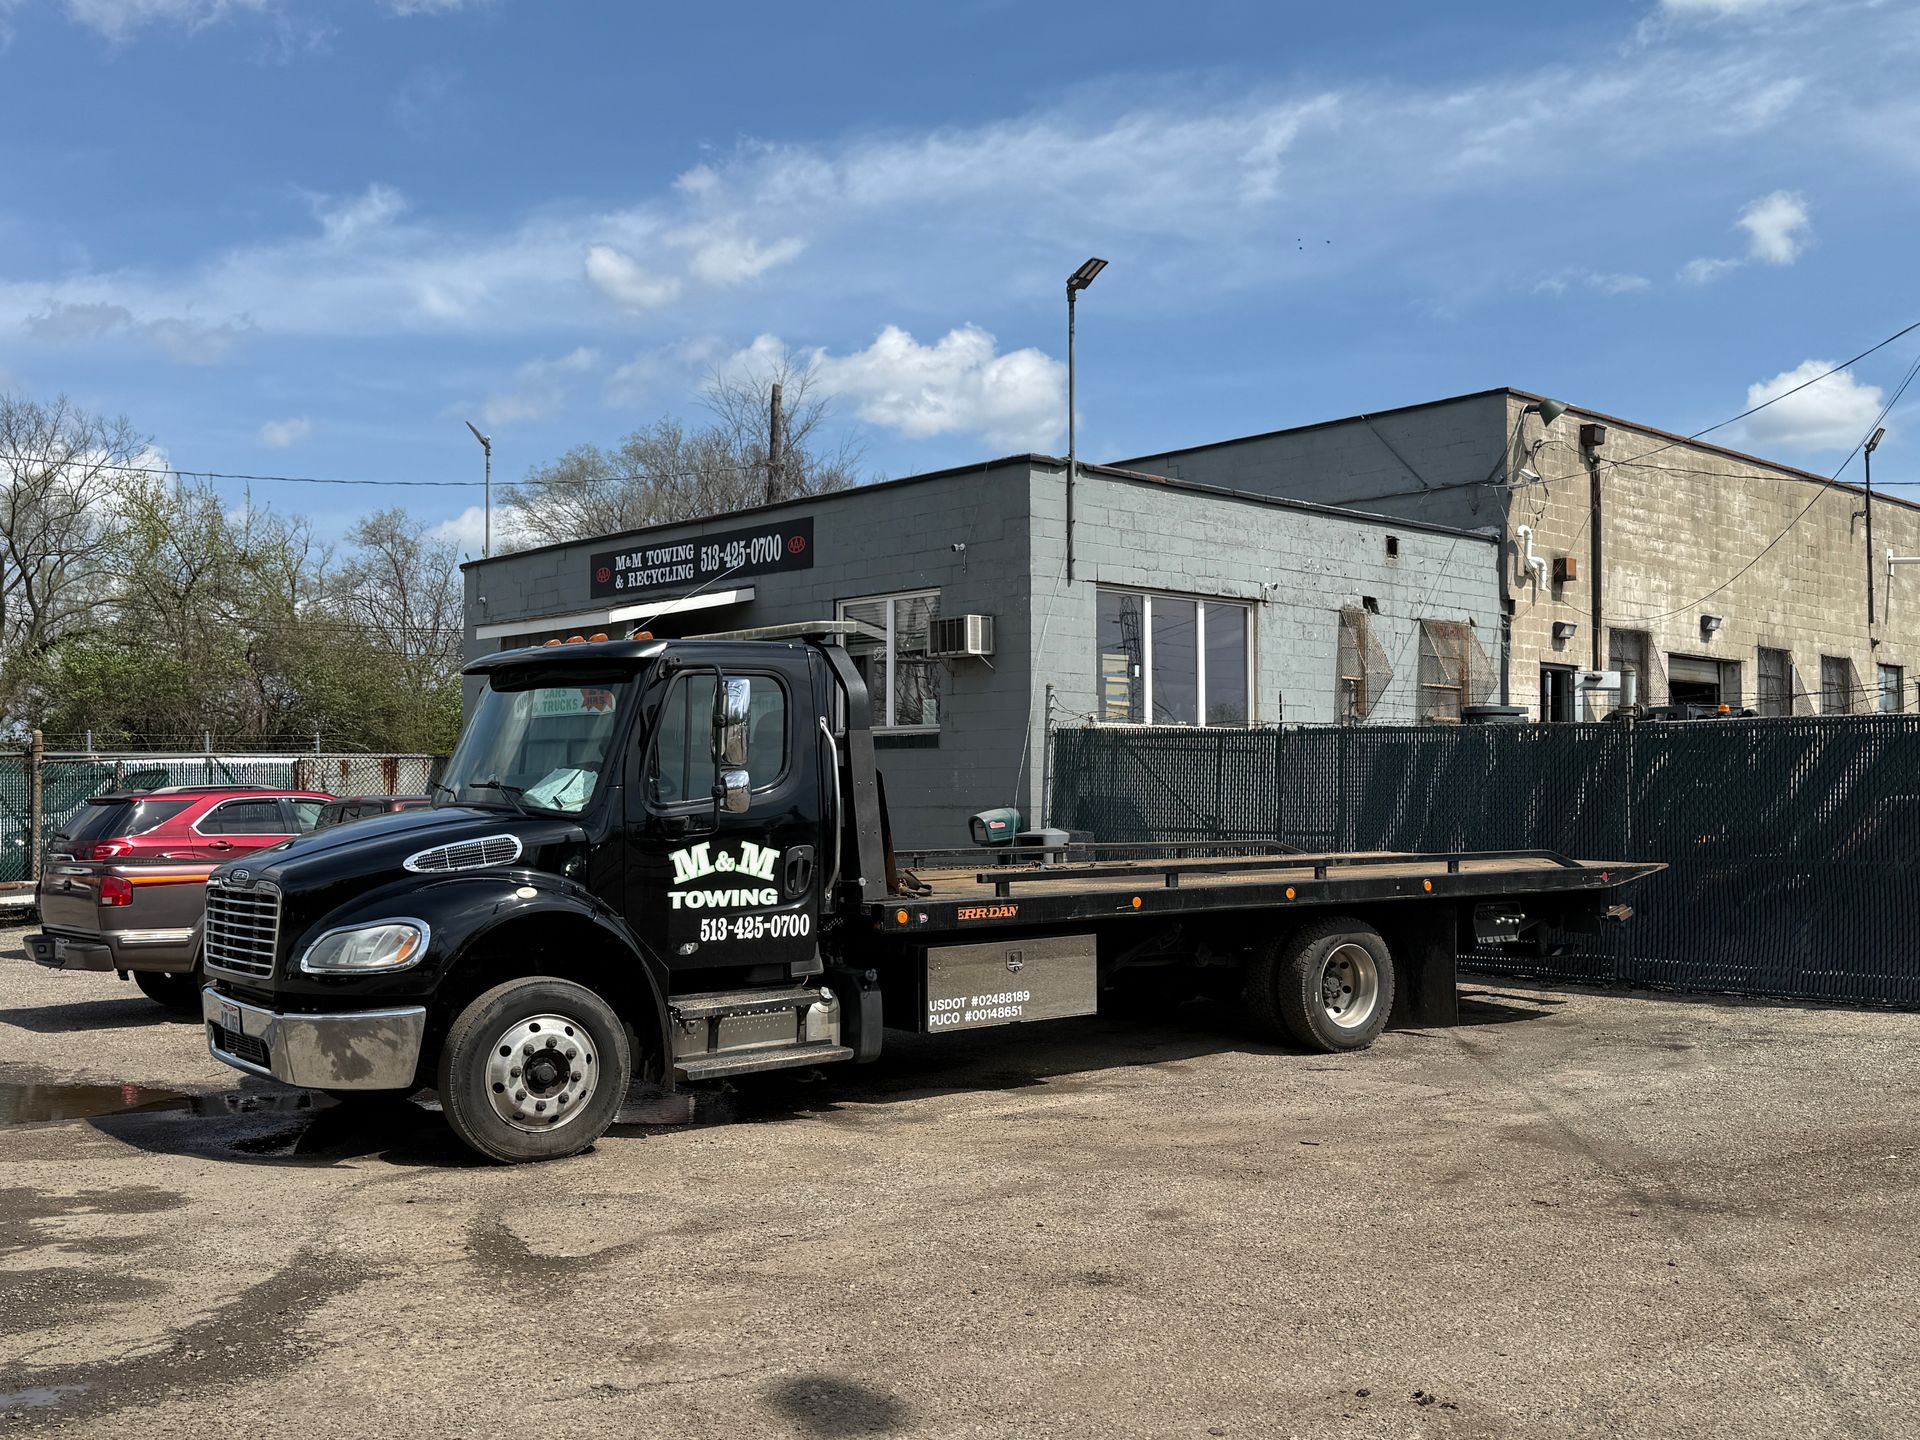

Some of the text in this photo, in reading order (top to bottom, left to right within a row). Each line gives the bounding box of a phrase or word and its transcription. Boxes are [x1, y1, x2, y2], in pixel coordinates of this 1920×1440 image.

[615, 543, 694, 571] M&M TOWING
[700, 534, 782, 573] 513-425-0700
[615, 564, 694, 589] & RECYCLING
[542, 699, 578, 713] TRUCKS
[668, 841, 781, 885] M&M
[667, 888, 778, 910] TOWING
[700, 914, 810, 942] 513-425-0700
[929, 990, 1030, 1012] USDOT #02488189
[929, 1005, 1022, 1026] PUCO #00148651
